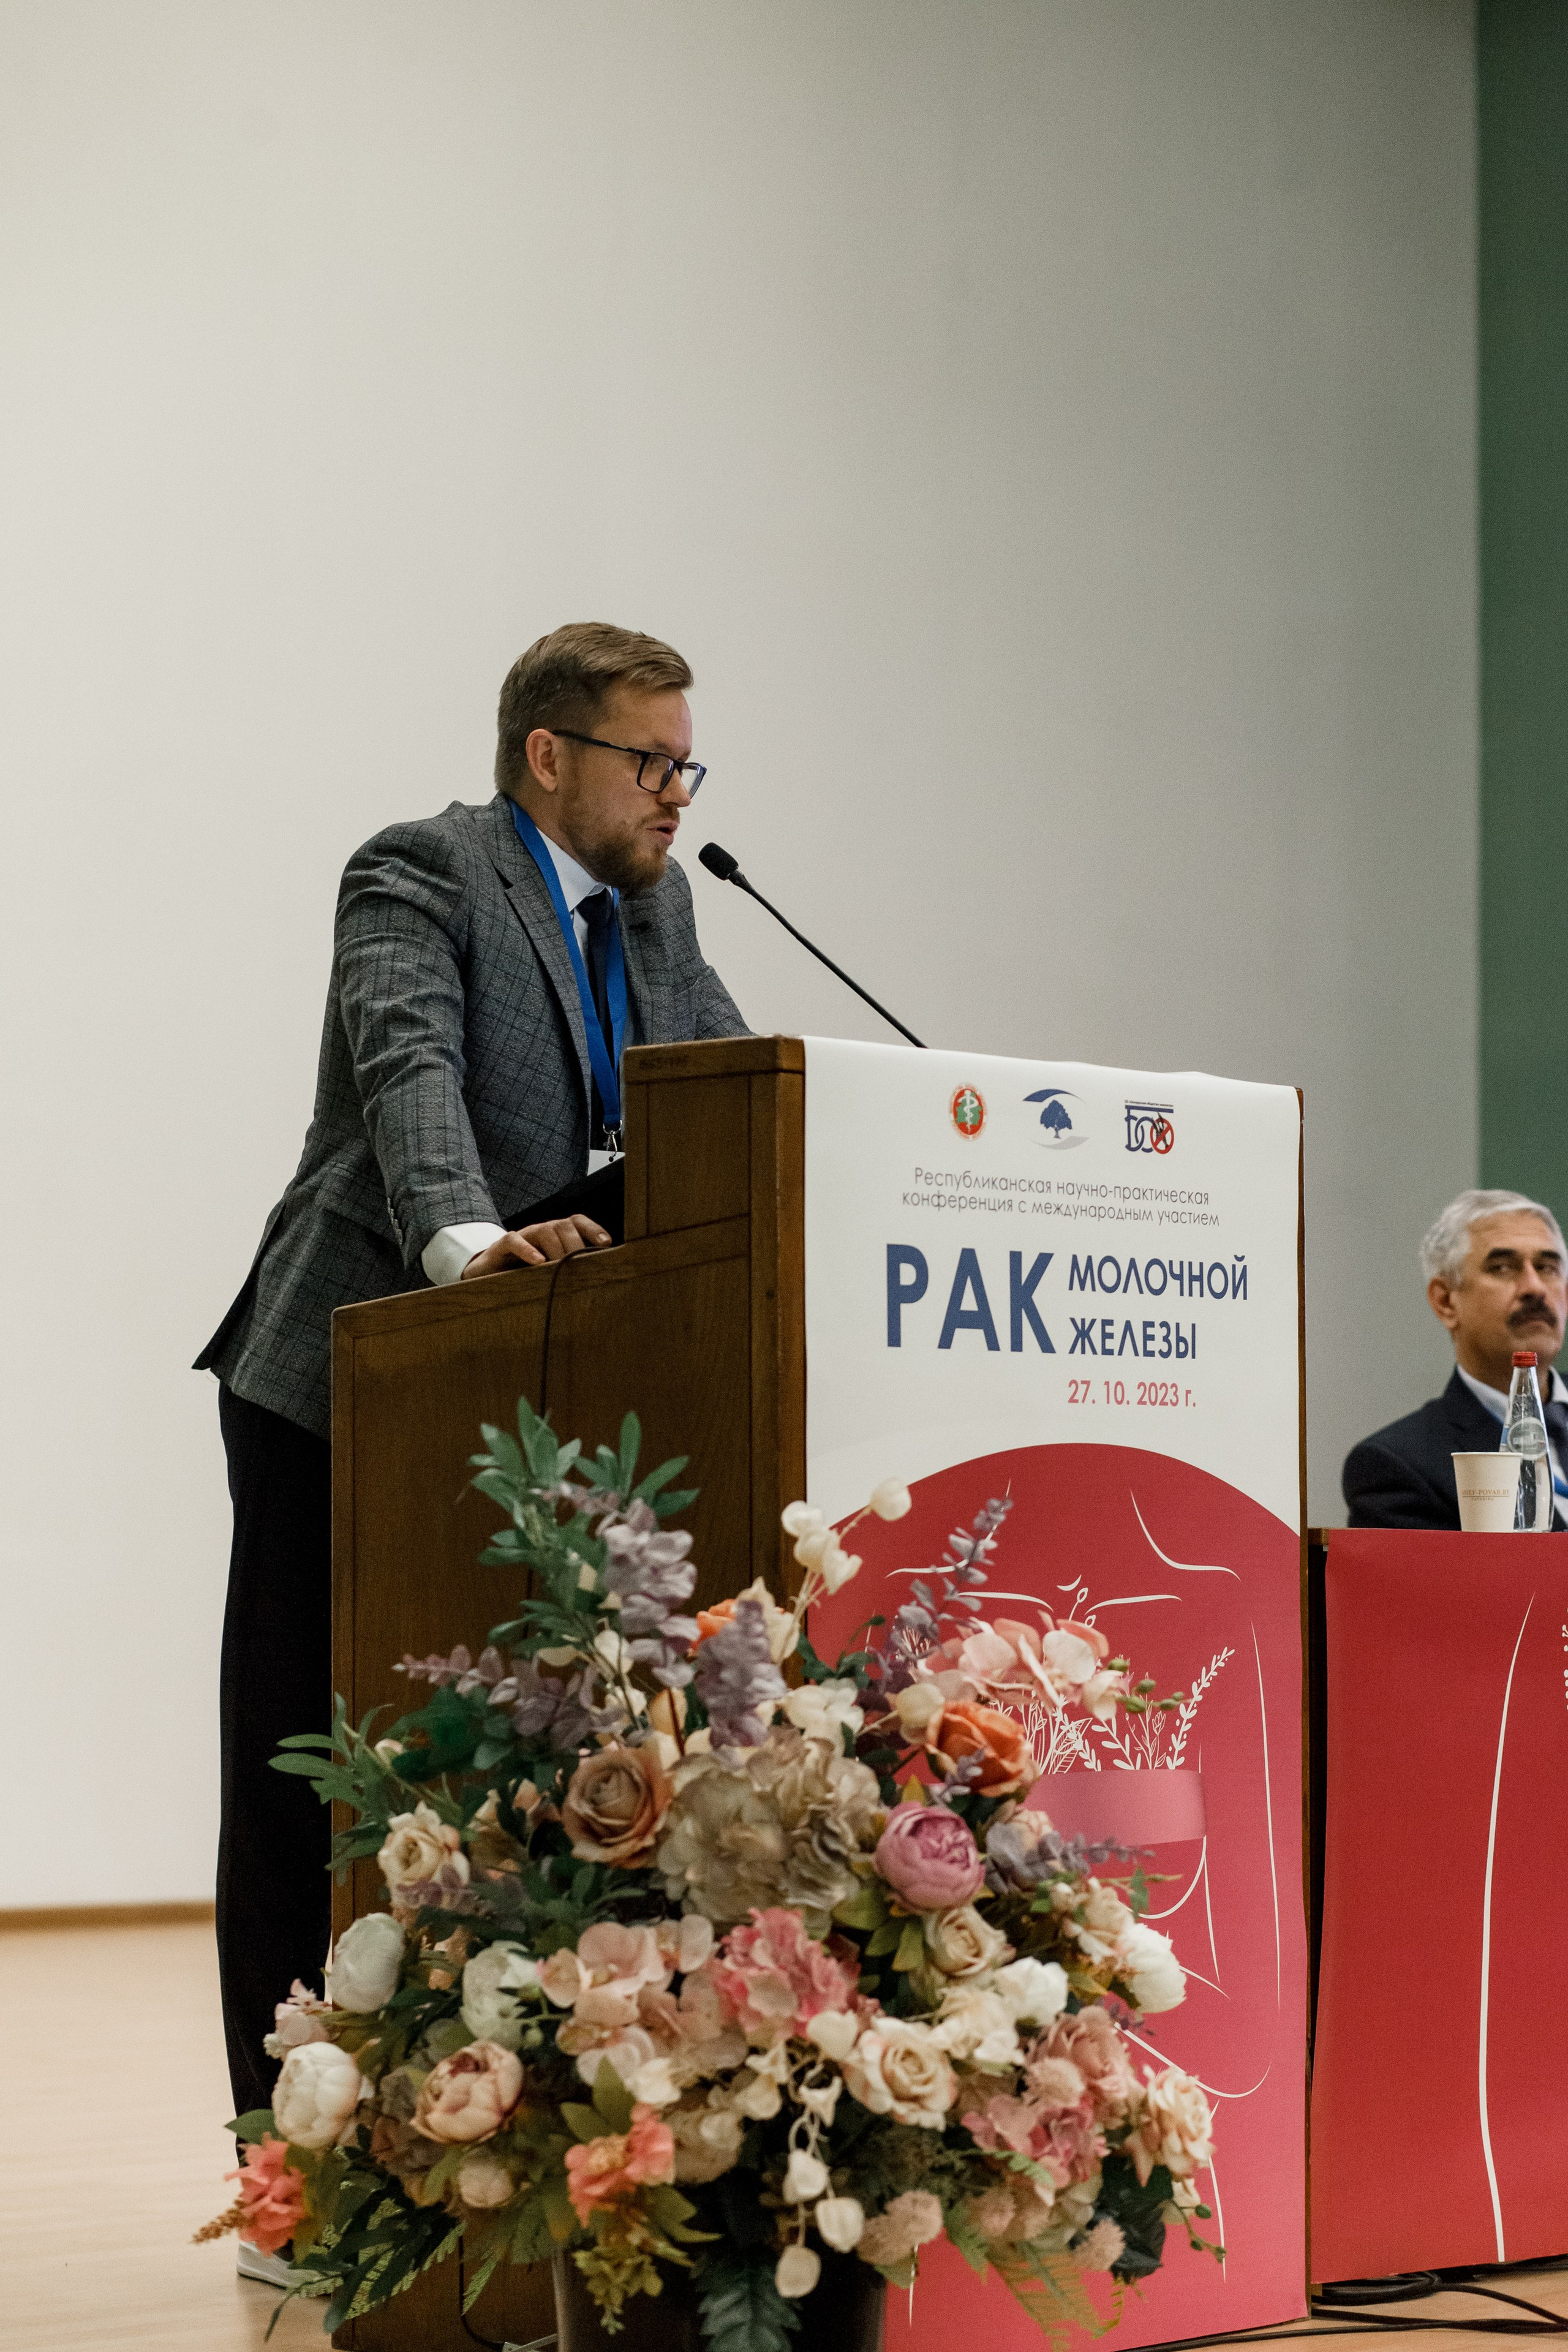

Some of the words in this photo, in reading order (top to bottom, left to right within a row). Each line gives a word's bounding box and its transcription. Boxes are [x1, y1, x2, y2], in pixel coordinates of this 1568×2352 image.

[914, 1167, 1051, 1194] Республиканская
[1057, 1182, 1209, 1205] научно-практическая
[902, 1191, 1013, 1213] конференция
[1018, 1200, 1027, 1213] с
[1031, 1201, 1153, 1222] международным
[1157, 1209, 1219, 1226] участием
[1068, 1254, 1248, 1300] МОЛОЧНОЙ
[886, 1243, 1056, 1354] РАК
[1068, 1317, 1196, 1359] ЖЕЛЕЗЫ
[1068, 1379, 1096, 1404] 27.
[1104, 1381, 1130, 1405] 10.
[1136, 1382, 1180, 1407] 2023
[1185, 1389, 1196, 1408] г.
